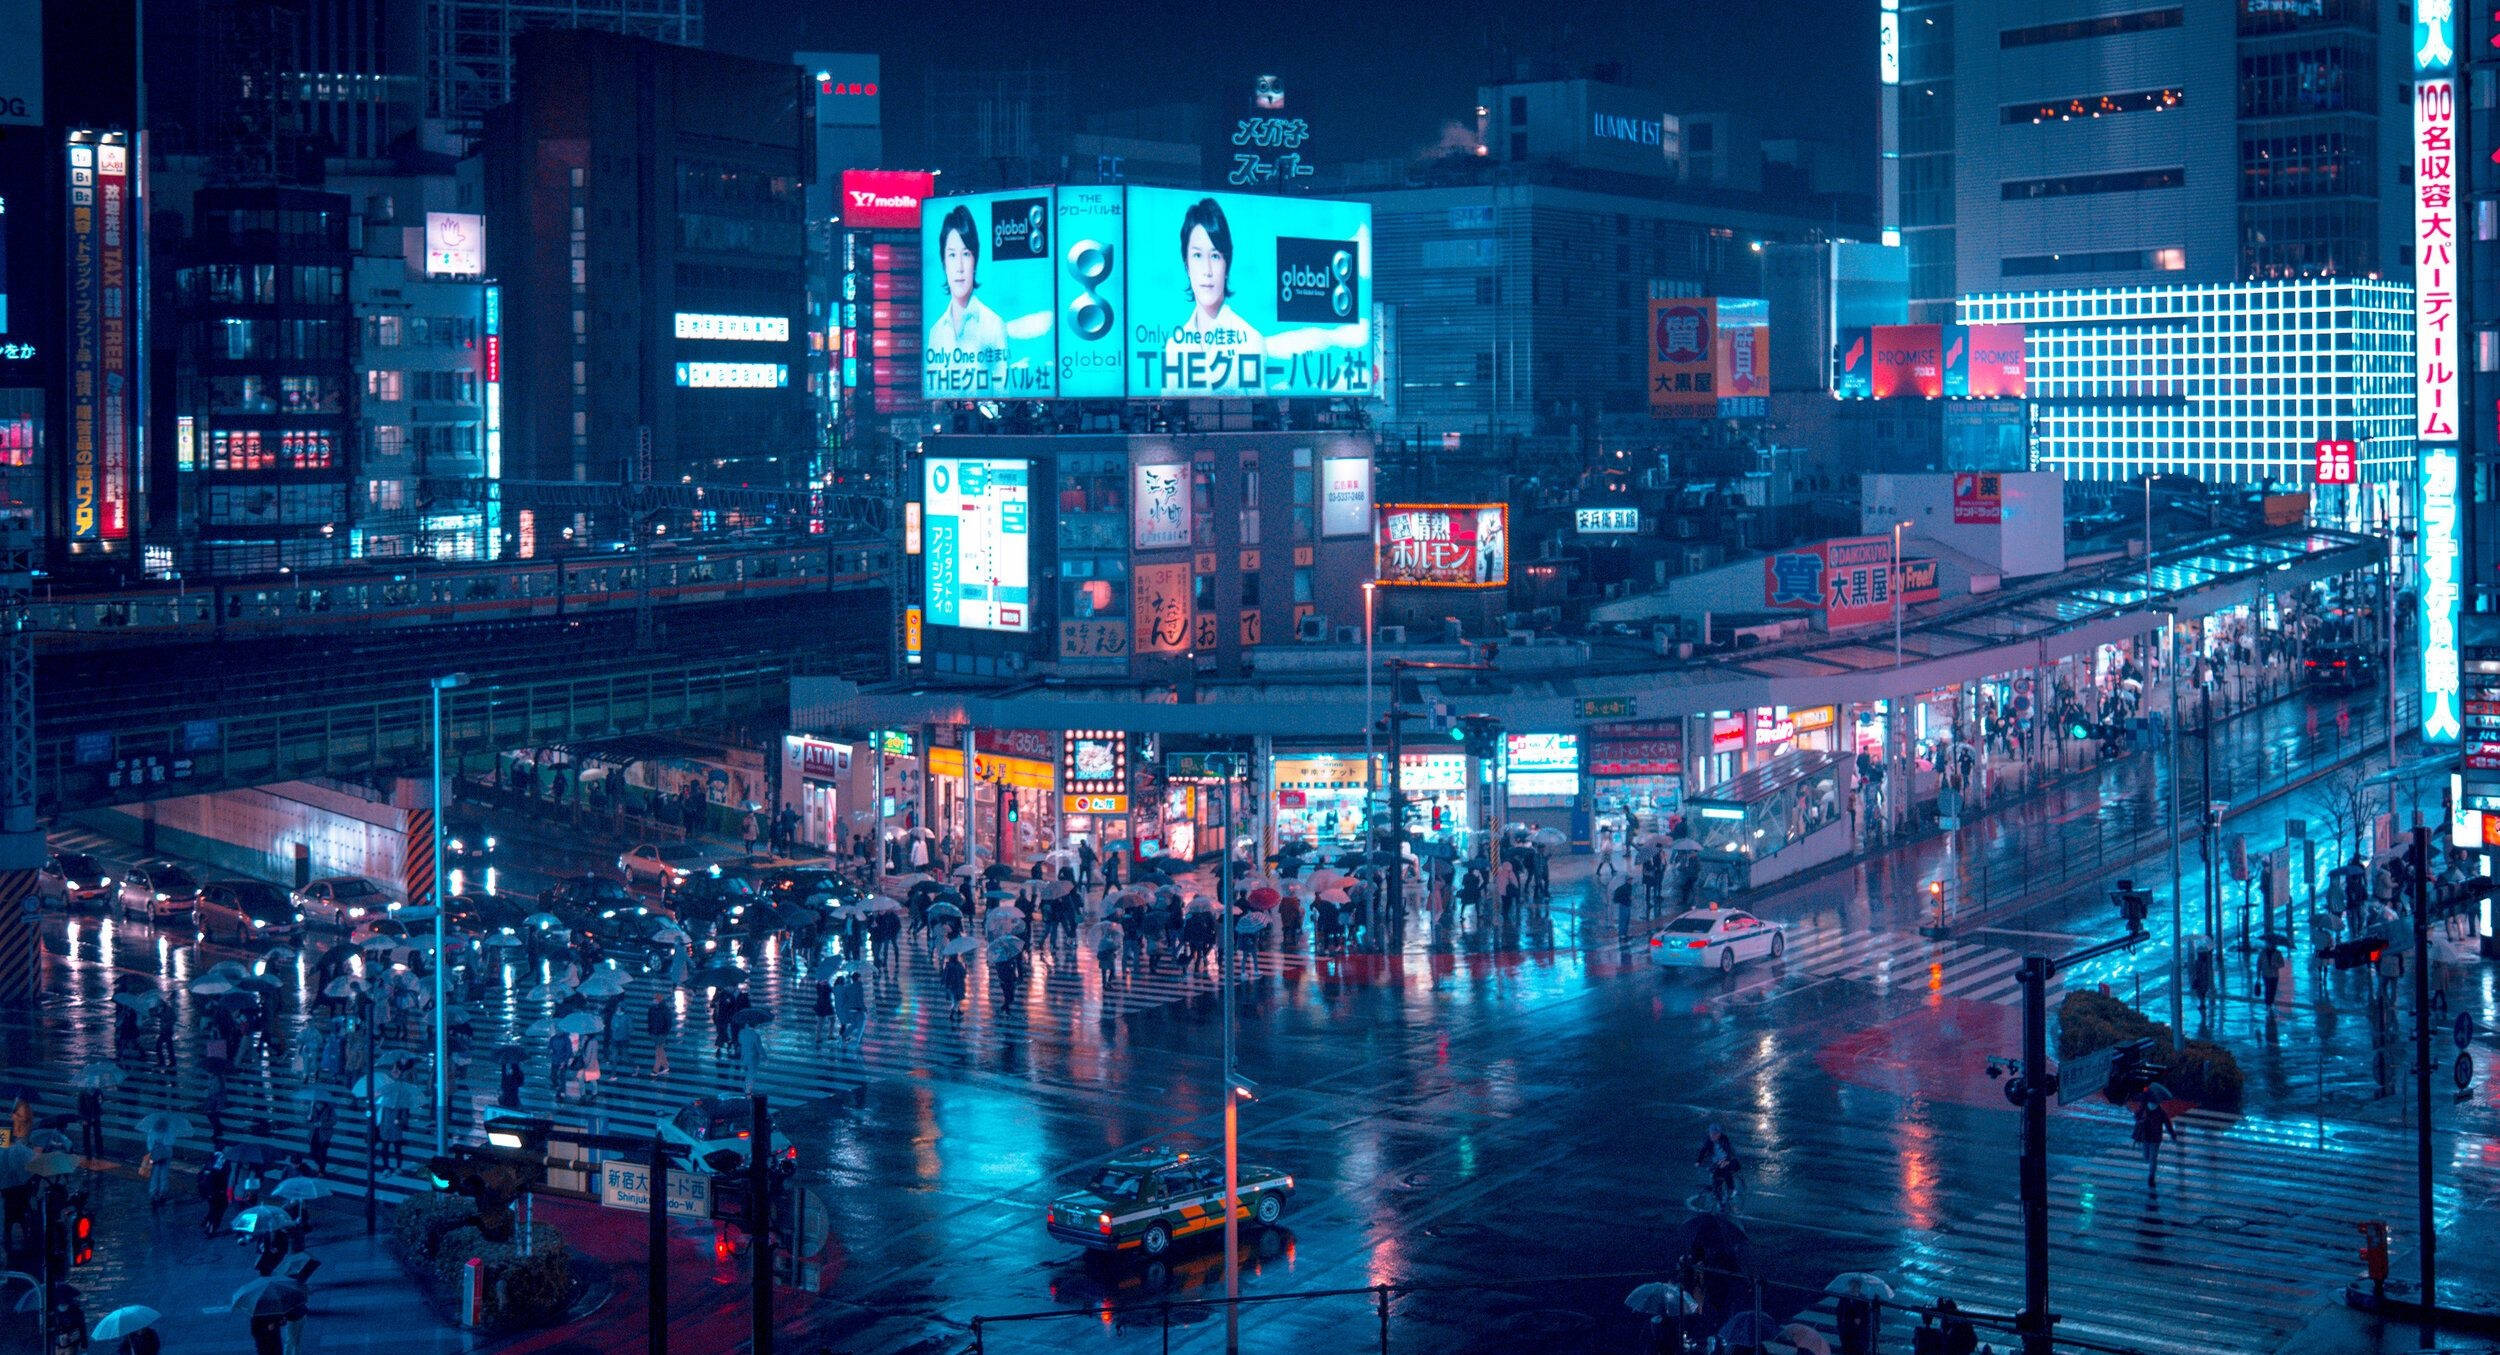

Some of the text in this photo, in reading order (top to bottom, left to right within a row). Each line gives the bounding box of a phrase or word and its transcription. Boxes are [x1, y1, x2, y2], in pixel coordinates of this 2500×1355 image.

[822, 82, 878, 96] KANO
[1232, 117, 1309, 149] メガネ
[1594, 111, 1661, 146] LUMINE EST
[1059, 205, 1122, 217] グローバル社
[1079, 194, 1103, 203] THE
[995, 217, 1028, 248] global
[2417, 84, 2453, 435] 100名収容大パーティールーム
[1281, 264, 1330, 303] global
[1135, 324, 1248, 349] Only One の住まい
[925, 347, 951, 368] Only
[953, 347, 976, 364] One
[1062, 350, 1122, 379] global
[1878, 349, 1936, 367] PROMISE
[1974, 349, 2020, 365] PROMISE
[926, 366, 1051, 391] THEグローバル社
[1136, 350, 1368, 391] THEグローバル社
[1654, 372, 1713, 393] 大黒屋
[1979, 476, 1999, 496] 薬
[1393, 540, 1470, 570] ホルモン
[931, 526, 944, 613] アイシティ
[1155, 570, 1173, 584] 3F
[1830, 568, 1889, 608] 大黒屋
[805, 745, 834, 766] ATM
[608, 1168, 705, 1200] 新宿大ード西
